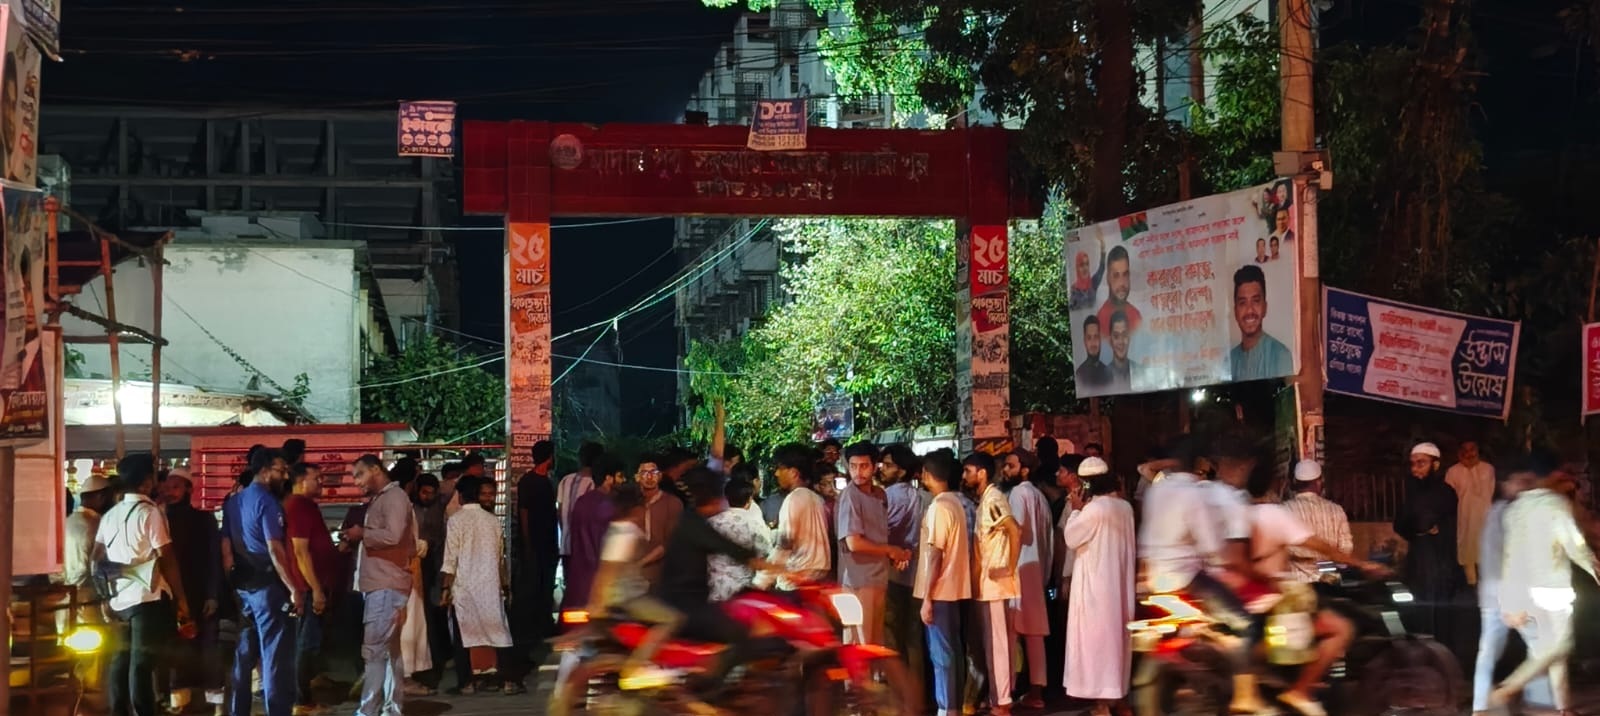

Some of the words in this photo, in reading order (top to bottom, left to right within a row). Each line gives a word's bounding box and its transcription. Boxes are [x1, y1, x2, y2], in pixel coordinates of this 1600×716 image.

[759, 102, 792, 120] DOT
[511, 231, 545, 266] ২৫
[974, 233, 1005, 267] ২৫
[515, 263, 545, 285] মার্চ
[976, 264, 1005, 285] মার্চ
[512, 295, 549, 313] গণহত্যা
[972, 295, 1007, 313] গণহত্যা
[526, 310, 550, 325] দিবস
[987, 310, 1008, 325] দিবস
[1459, 330, 1509, 367] উদ্ভাস
[1457, 362, 1507, 397] উন্মেষ
